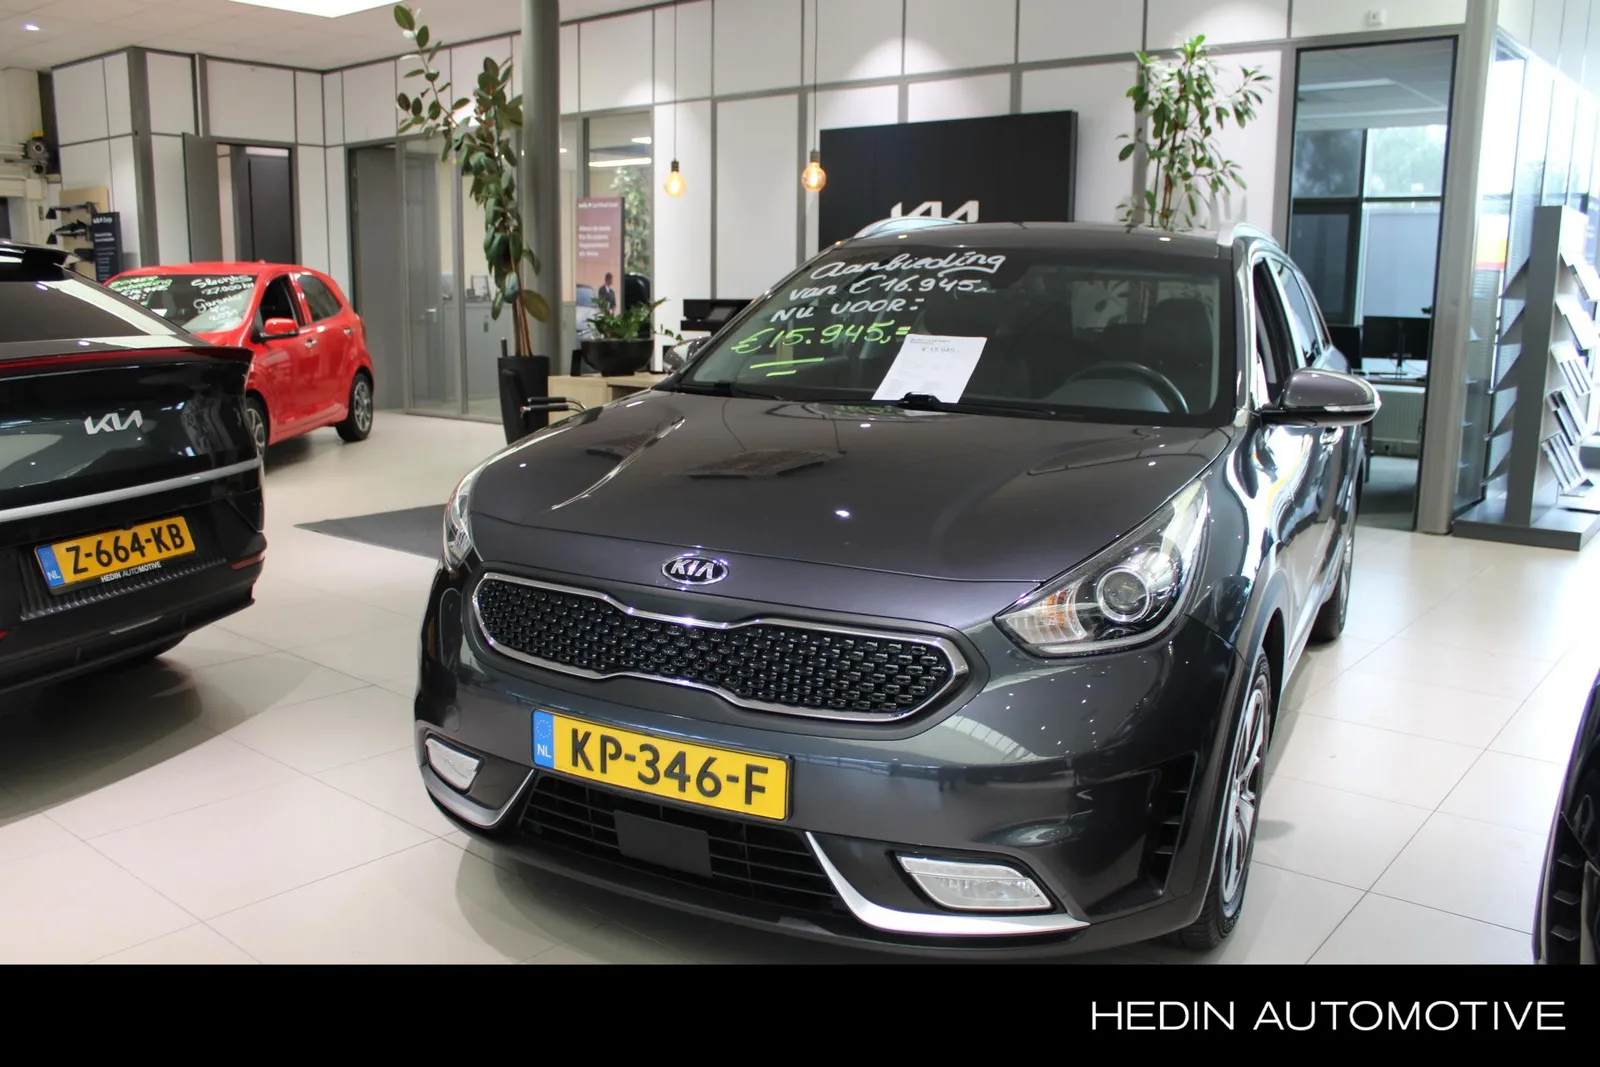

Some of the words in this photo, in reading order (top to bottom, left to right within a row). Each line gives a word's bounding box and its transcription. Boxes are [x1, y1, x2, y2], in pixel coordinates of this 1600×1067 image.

[789, 284, 837, 301] van
[84, 410, 143, 435] KIA
[66, 523, 185, 575] Z-664-KB
[47, 570, 61, 580] NL
[101, 571, 122, 583] HEDIN
[122, 561, 162, 577] AUTOMOTIVE
[670, 559, 715, 580] KIA
[537, 743, 552, 758] NL
[571, 727, 769, 805] KP-346-F
